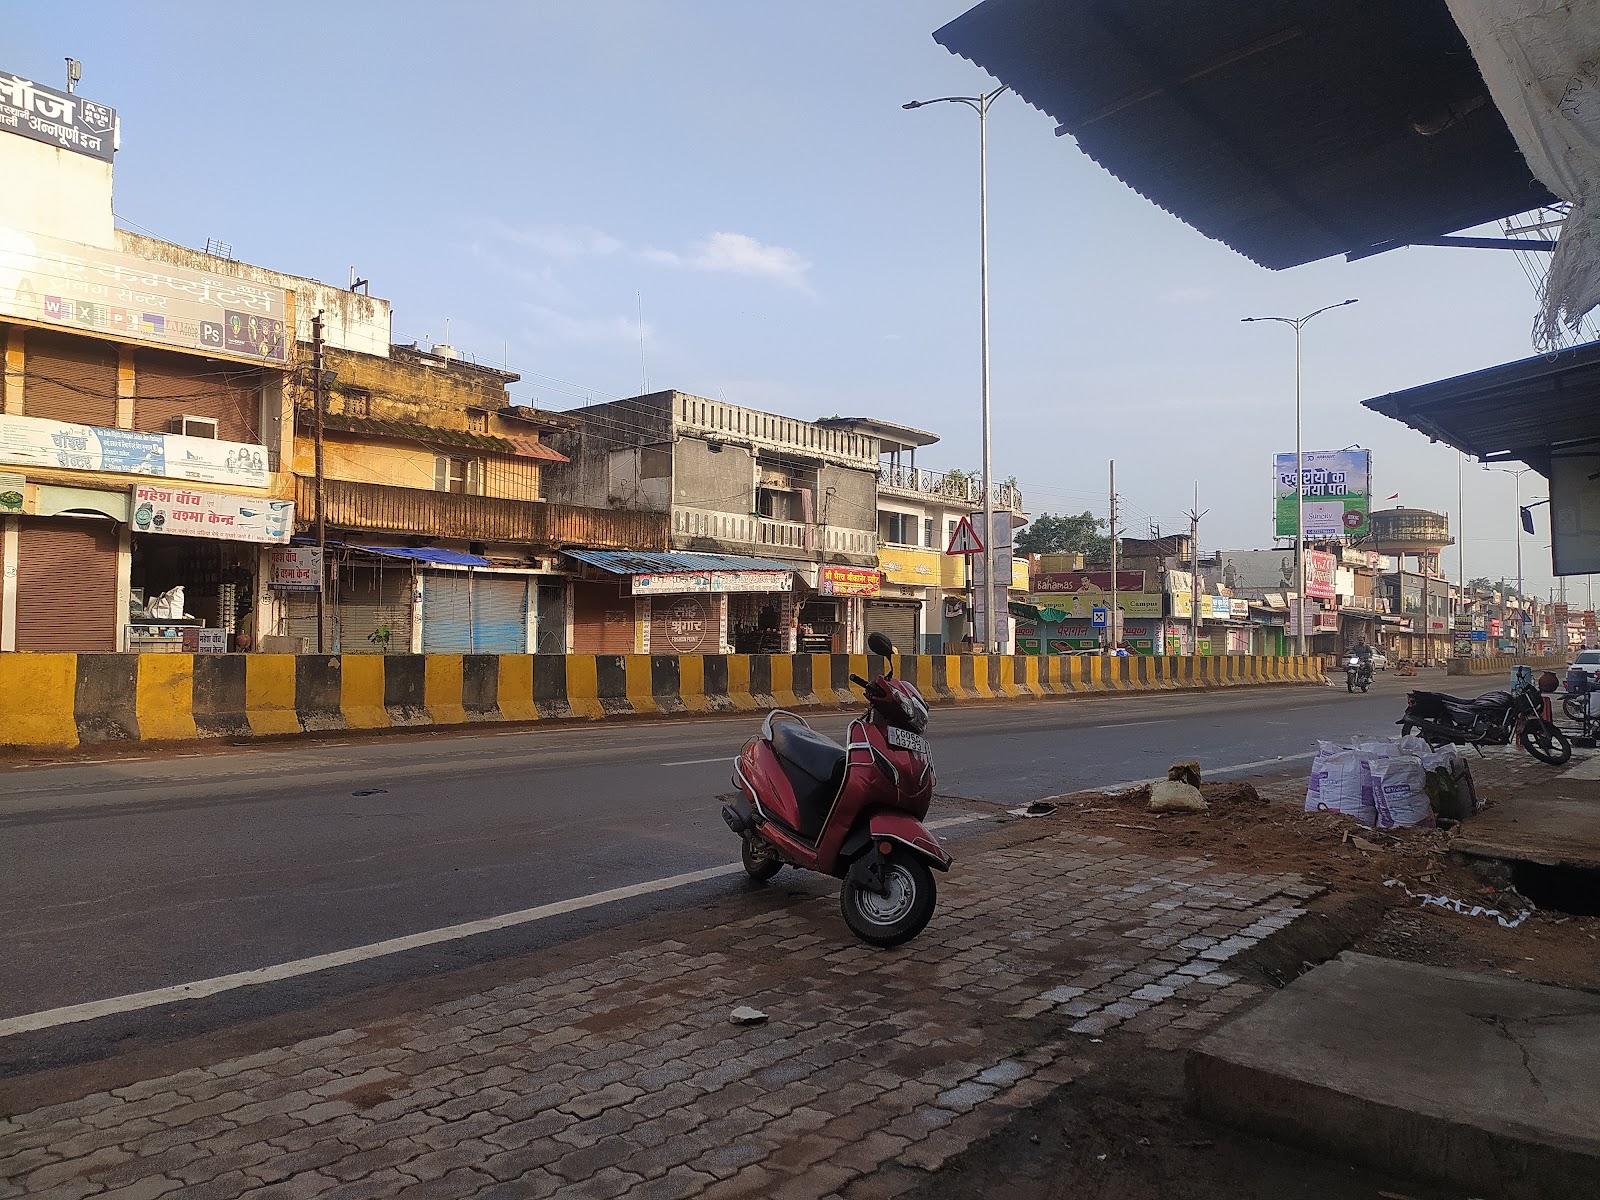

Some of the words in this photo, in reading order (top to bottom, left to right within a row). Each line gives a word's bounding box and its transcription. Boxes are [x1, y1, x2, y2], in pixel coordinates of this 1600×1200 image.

[29, 116, 79, 147] अन्नपूर्णा
[80, 132, 102, 151] इन
[117, 283, 167, 309] सेन्टर
[204, 324, 220, 342] Ps
[1330, 471, 1348, 483] का
[138, 488, 172, 503] महेश
[176, 490, 202, 505] वॉच
[1328, 483, 1348, 495] पता
[172, 510, 205, 523] चश्मा
[208, 510, 235, 525] केन्द्र
[272, 550, 285, 562] महेश
[285, 550, 297, 562] वॉच
[1037, 577, 1073, 590] Bahamas
